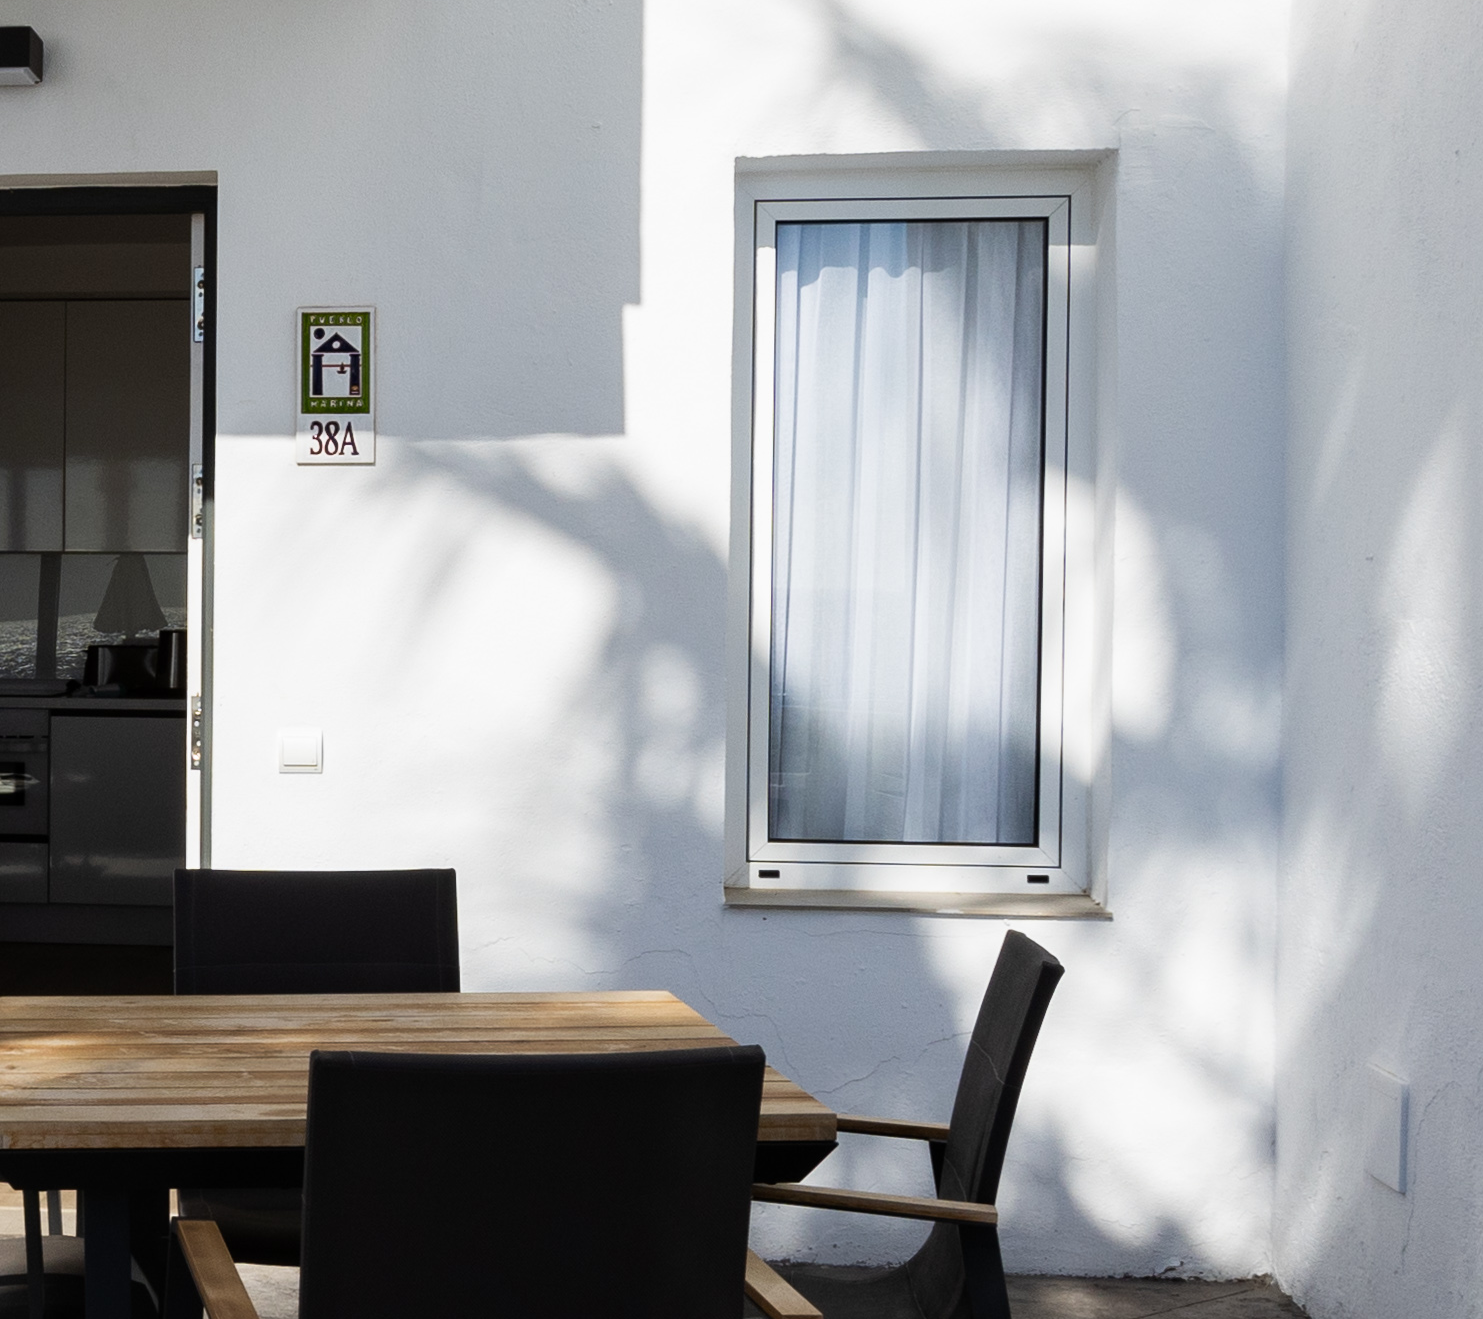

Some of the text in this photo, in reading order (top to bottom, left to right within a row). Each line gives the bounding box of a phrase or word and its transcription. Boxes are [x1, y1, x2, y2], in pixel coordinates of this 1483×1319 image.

[309, 315, 363, 324] PUEBLO
[310, 399, 364, 408] MARINA
[309, 420, 360, 456] 38A
